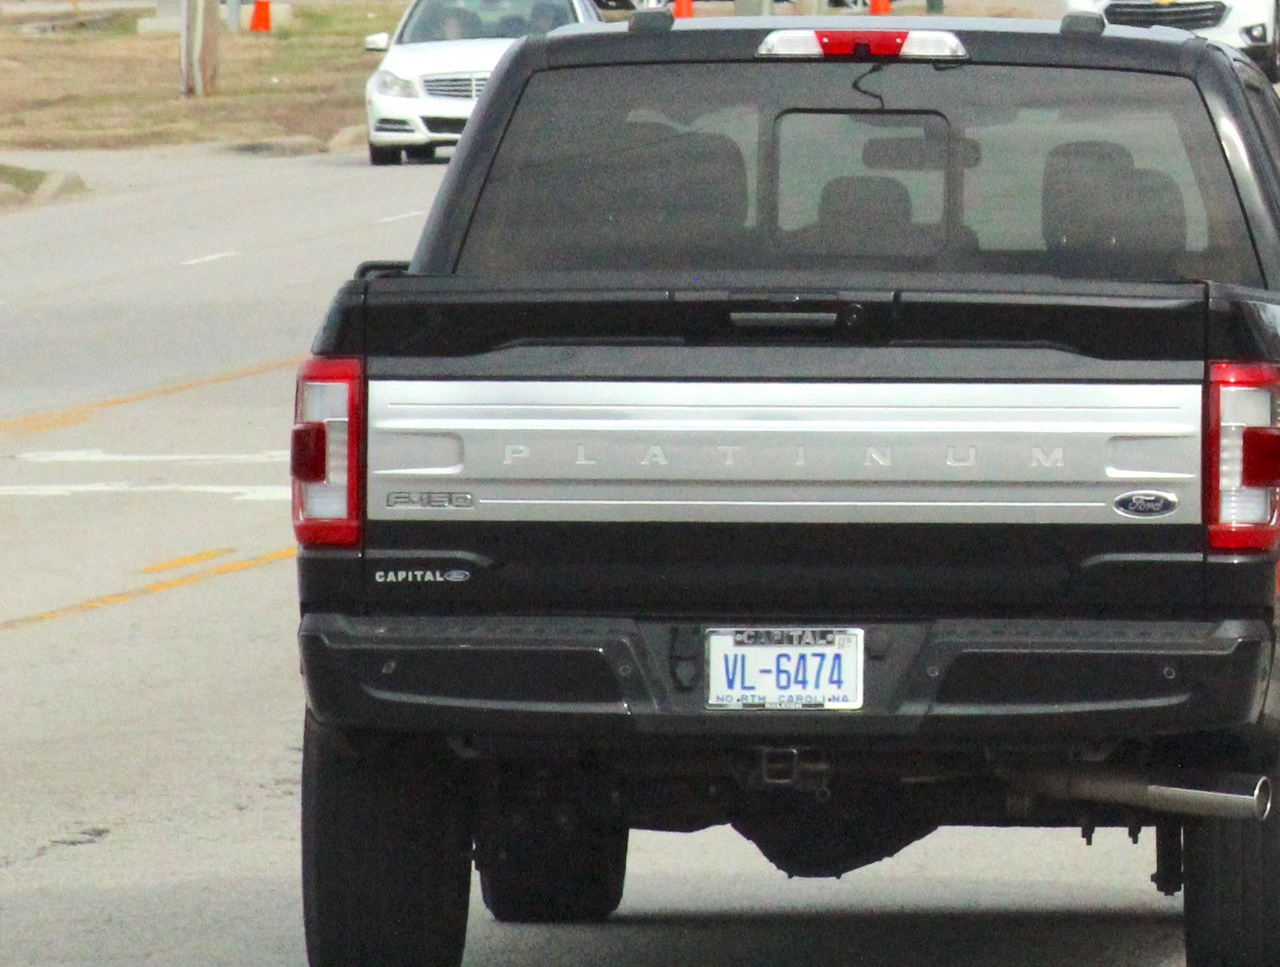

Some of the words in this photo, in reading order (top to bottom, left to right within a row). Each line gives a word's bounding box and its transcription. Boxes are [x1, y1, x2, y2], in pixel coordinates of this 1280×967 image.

[504, 444, 1064, 467] PLATINUM
[386, 491, 474, 508] F-150
[375, 570, 445, 582] CAPITAL
[742, 631, 827, 645] CAPITAL
[724, 653, 844, 691] VL-6474
[778, 694, 850, 703] CAROLINA
